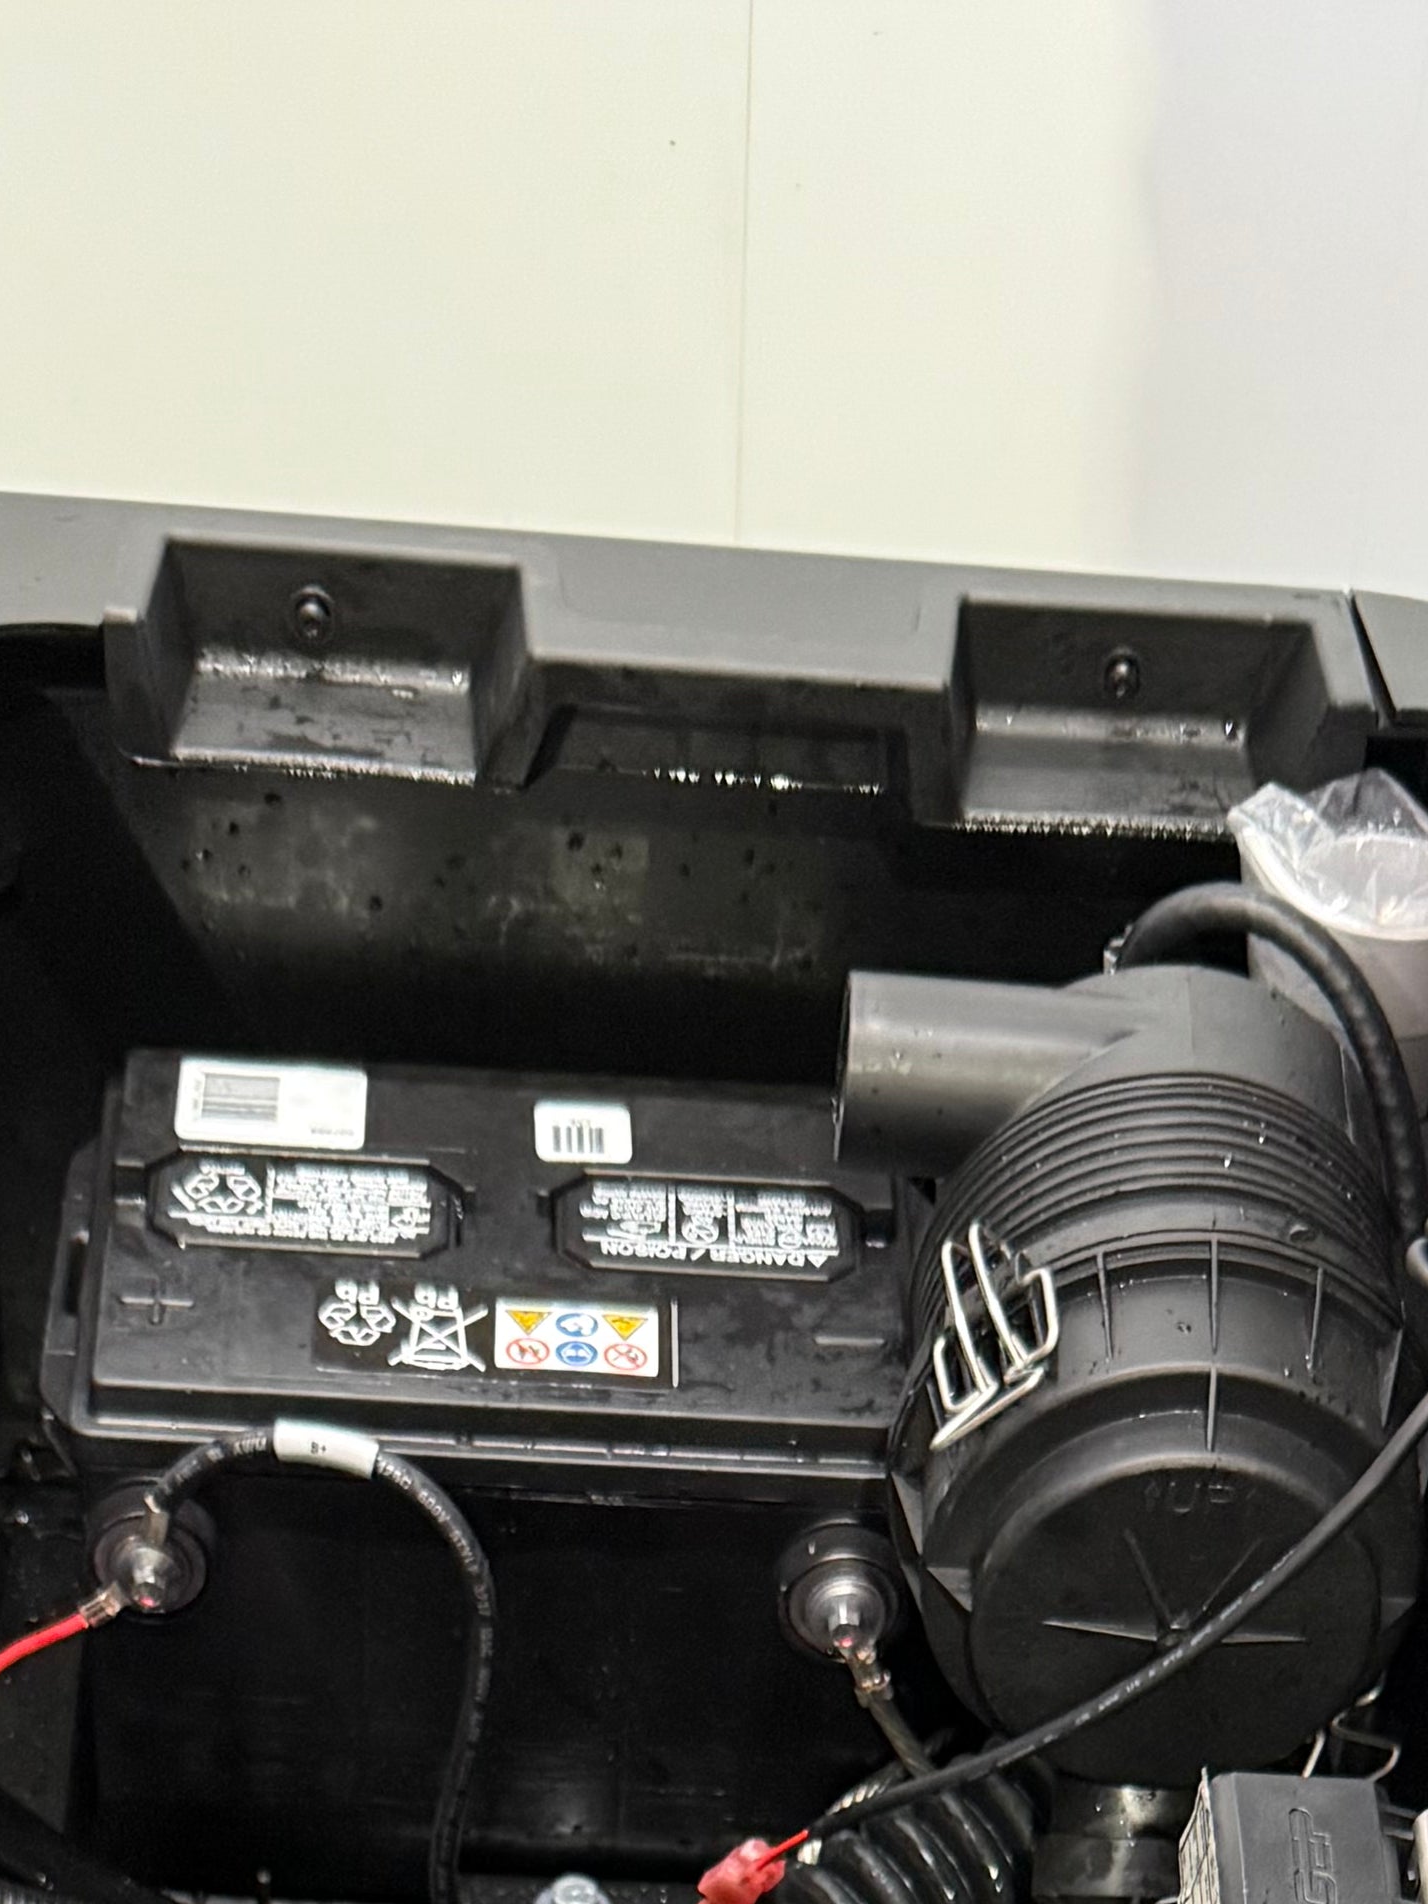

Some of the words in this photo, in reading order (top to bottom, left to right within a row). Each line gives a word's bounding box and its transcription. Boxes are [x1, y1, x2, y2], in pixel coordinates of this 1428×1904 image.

[601, 1241, 688, 1260] POISON
[710, 1249, 806, 1267] DANGER
[335, 1280, 381, 1306] Pb
[414, 1281, 460, 1309] Pb
